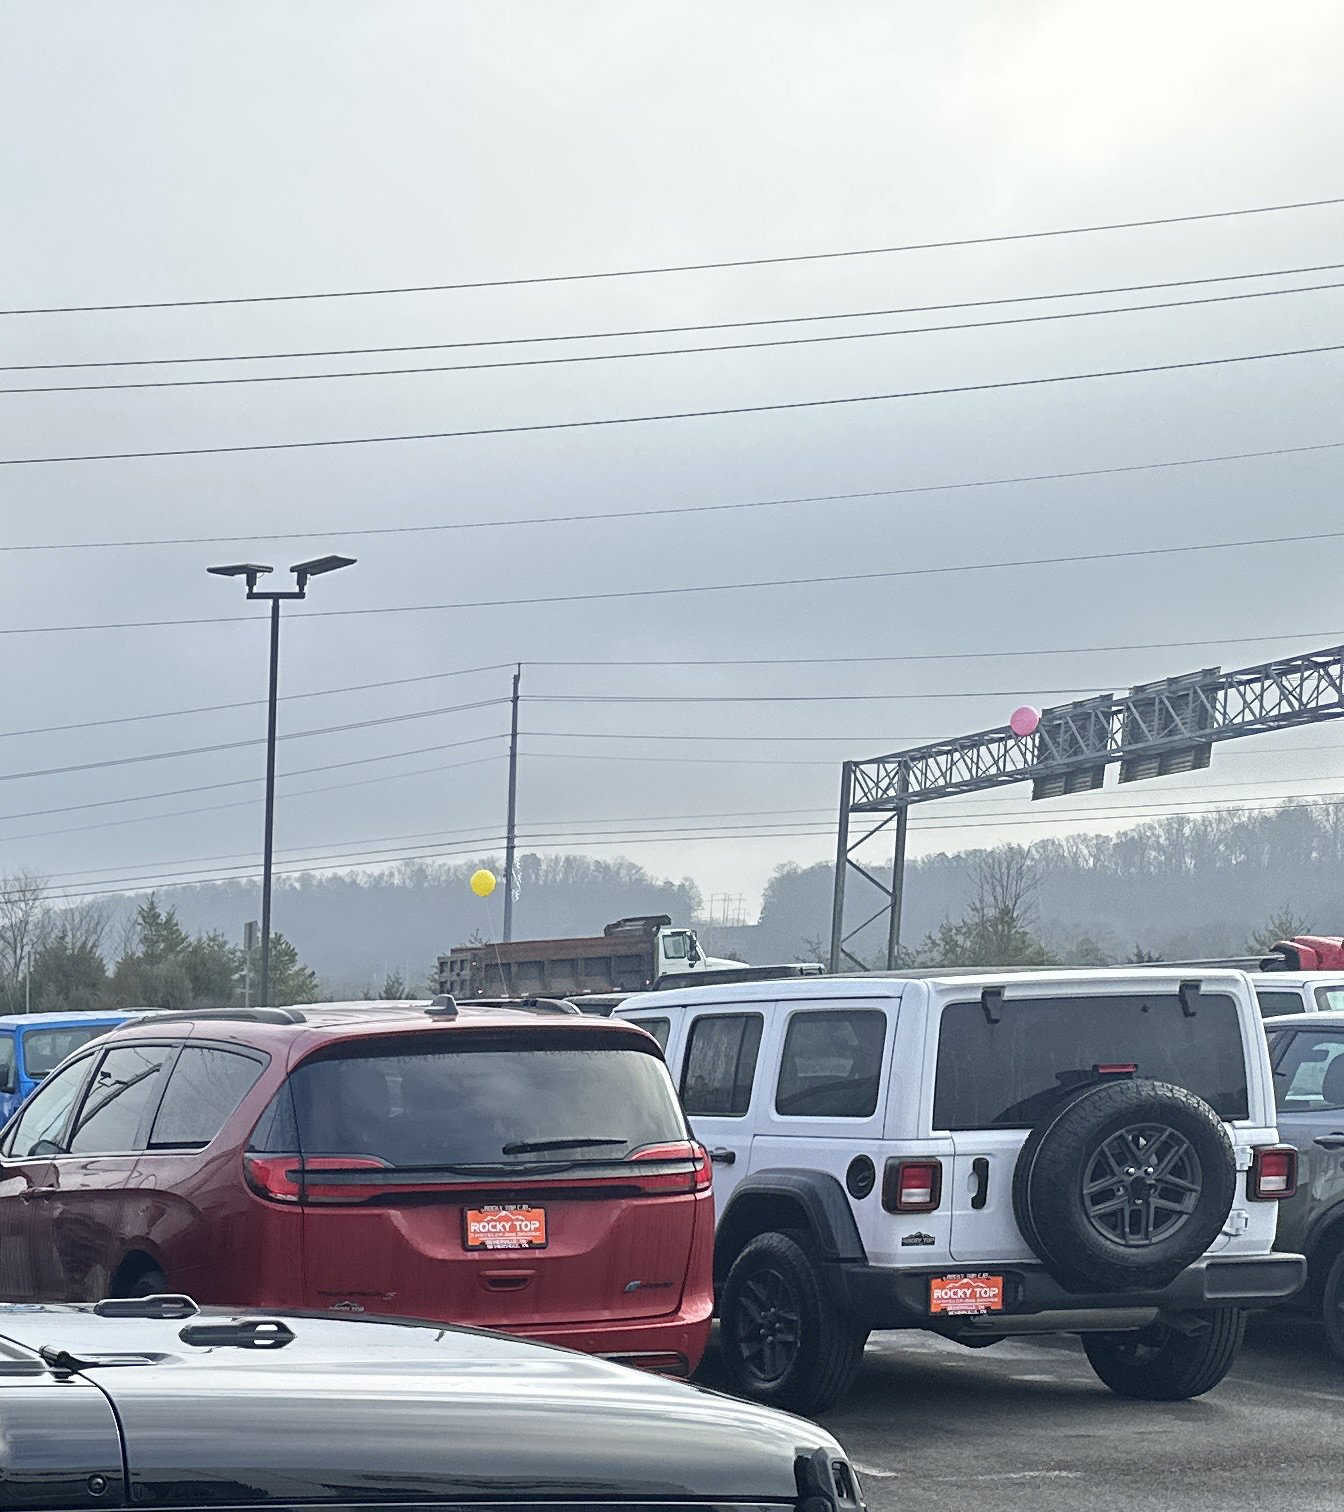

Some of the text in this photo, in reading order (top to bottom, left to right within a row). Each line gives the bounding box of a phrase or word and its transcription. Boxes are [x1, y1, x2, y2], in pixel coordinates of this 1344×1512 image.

[470, 1221, 540, 1232] ROCKY TOP
[933, 1288, 999, 1299] ROCKY TOP
